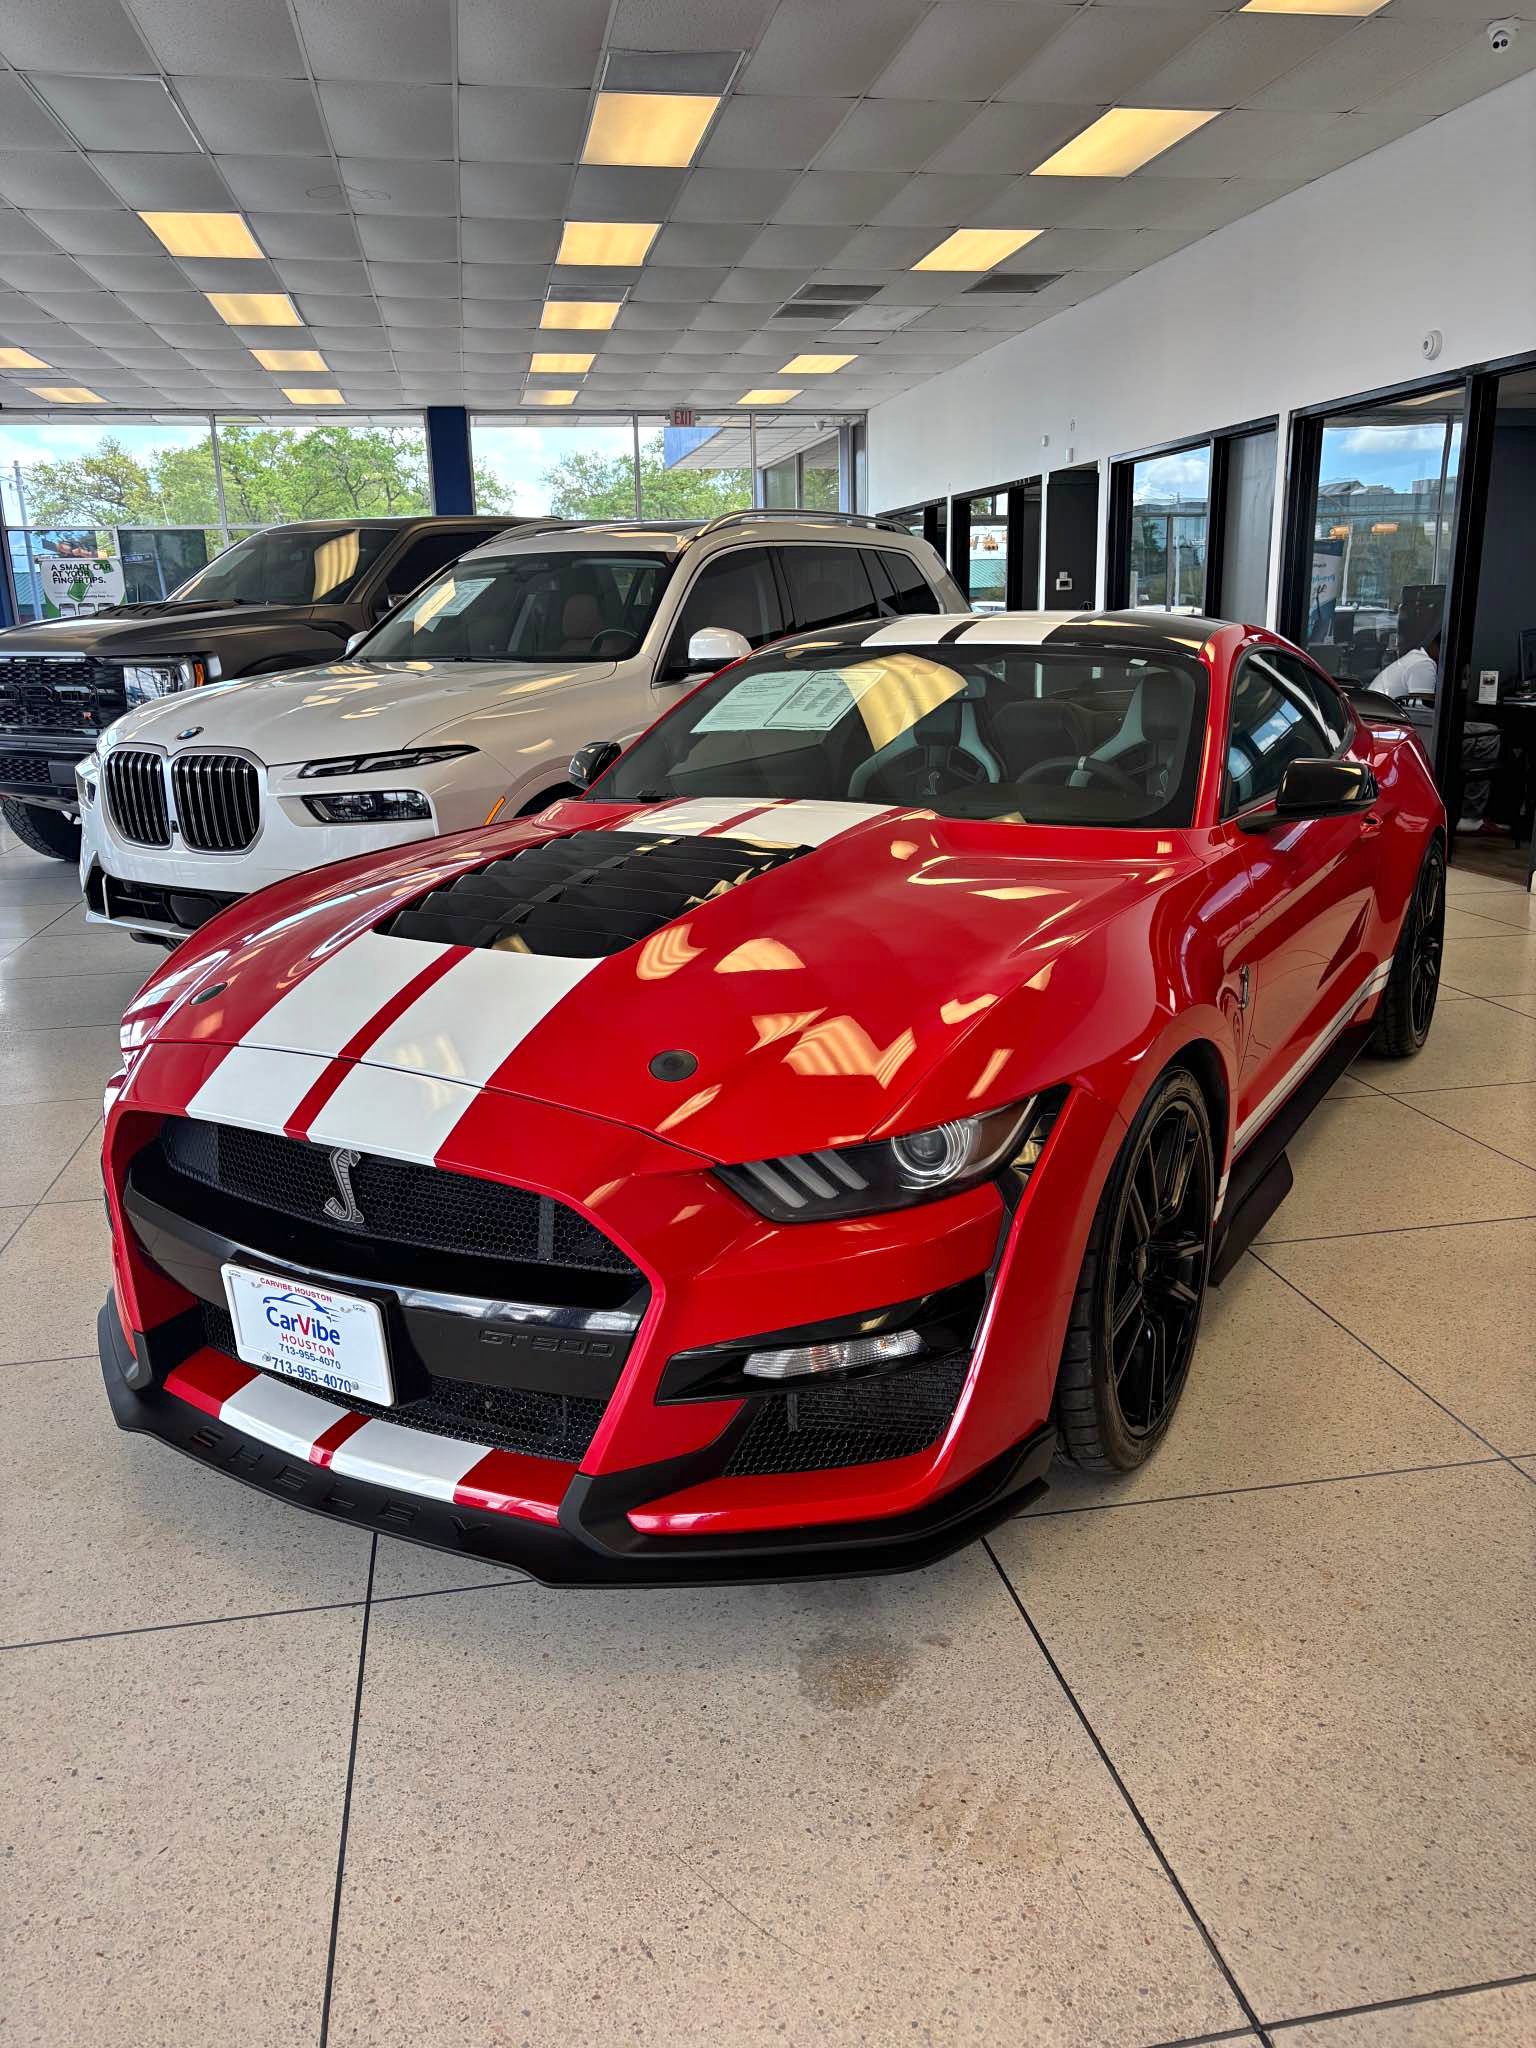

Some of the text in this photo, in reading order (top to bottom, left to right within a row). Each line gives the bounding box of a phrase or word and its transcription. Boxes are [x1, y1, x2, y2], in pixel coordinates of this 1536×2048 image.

[674, 410, 692, 424] EXIT
[53, 576, 106, 584] FINGERTIPS.
[60, 563, 90, 571] SMART
[93, 563, 111, 571] CAR
[260, 1277, 333, 1302] CARVIBE HOUSTON
[266, 1306, 341, 1345] CarVibe
[281, 1333, 335, 1357] HOUSTON
[479, 1328, 616, 1357] GT500
[279, 1343, 341, 1370] 713-955-4070
[271, 1356, 352, 1393] 713-955-4070
[189, 1424, 491, 1537] SHELBY
